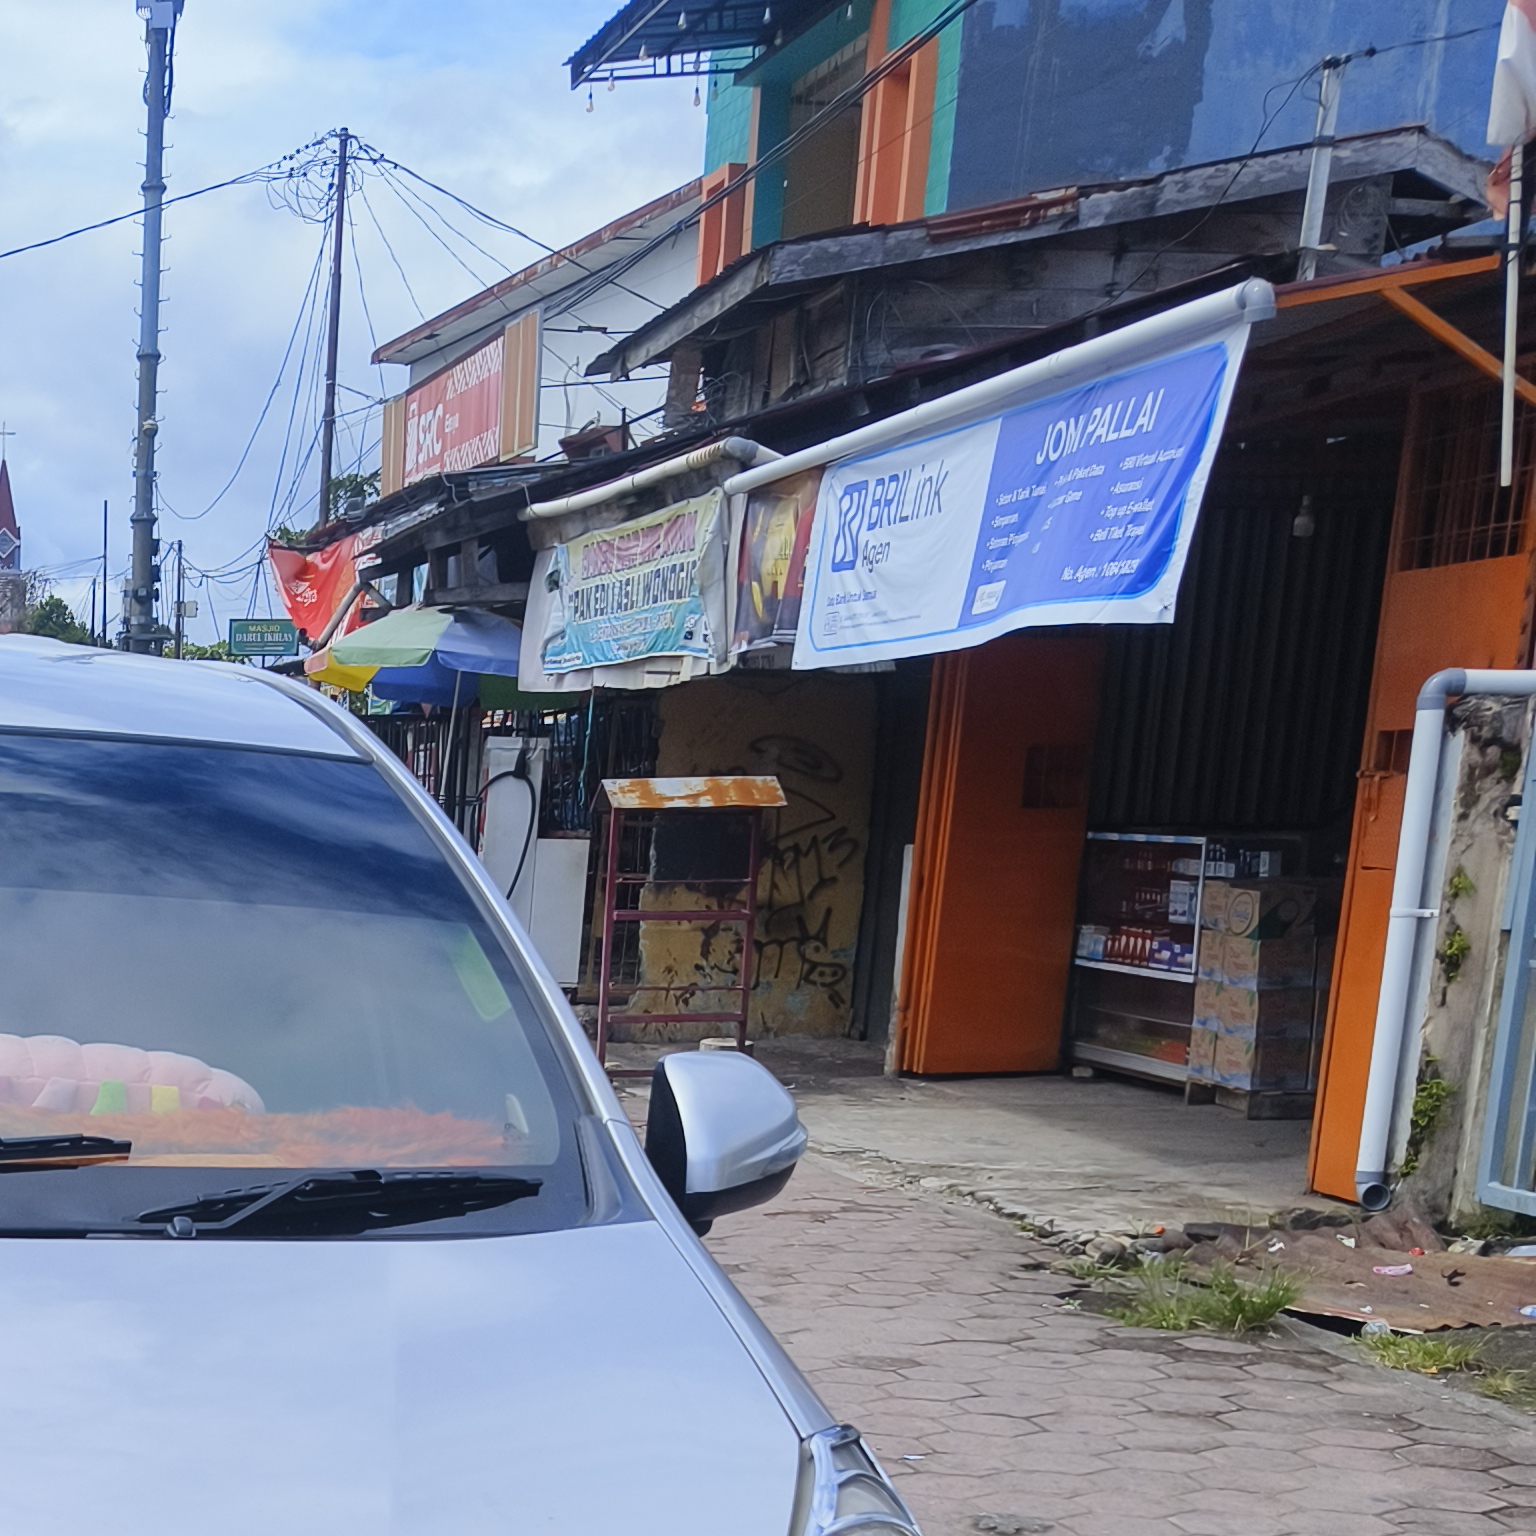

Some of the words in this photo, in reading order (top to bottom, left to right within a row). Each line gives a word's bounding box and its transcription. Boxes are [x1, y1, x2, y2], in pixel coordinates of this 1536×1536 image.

[1080, 388, 1164, 449] PALLAI
[866, 459, 949, 532] BRILink
[861, 538, 891, 574] Agen
[248, 624, 280, 633] MASJID
